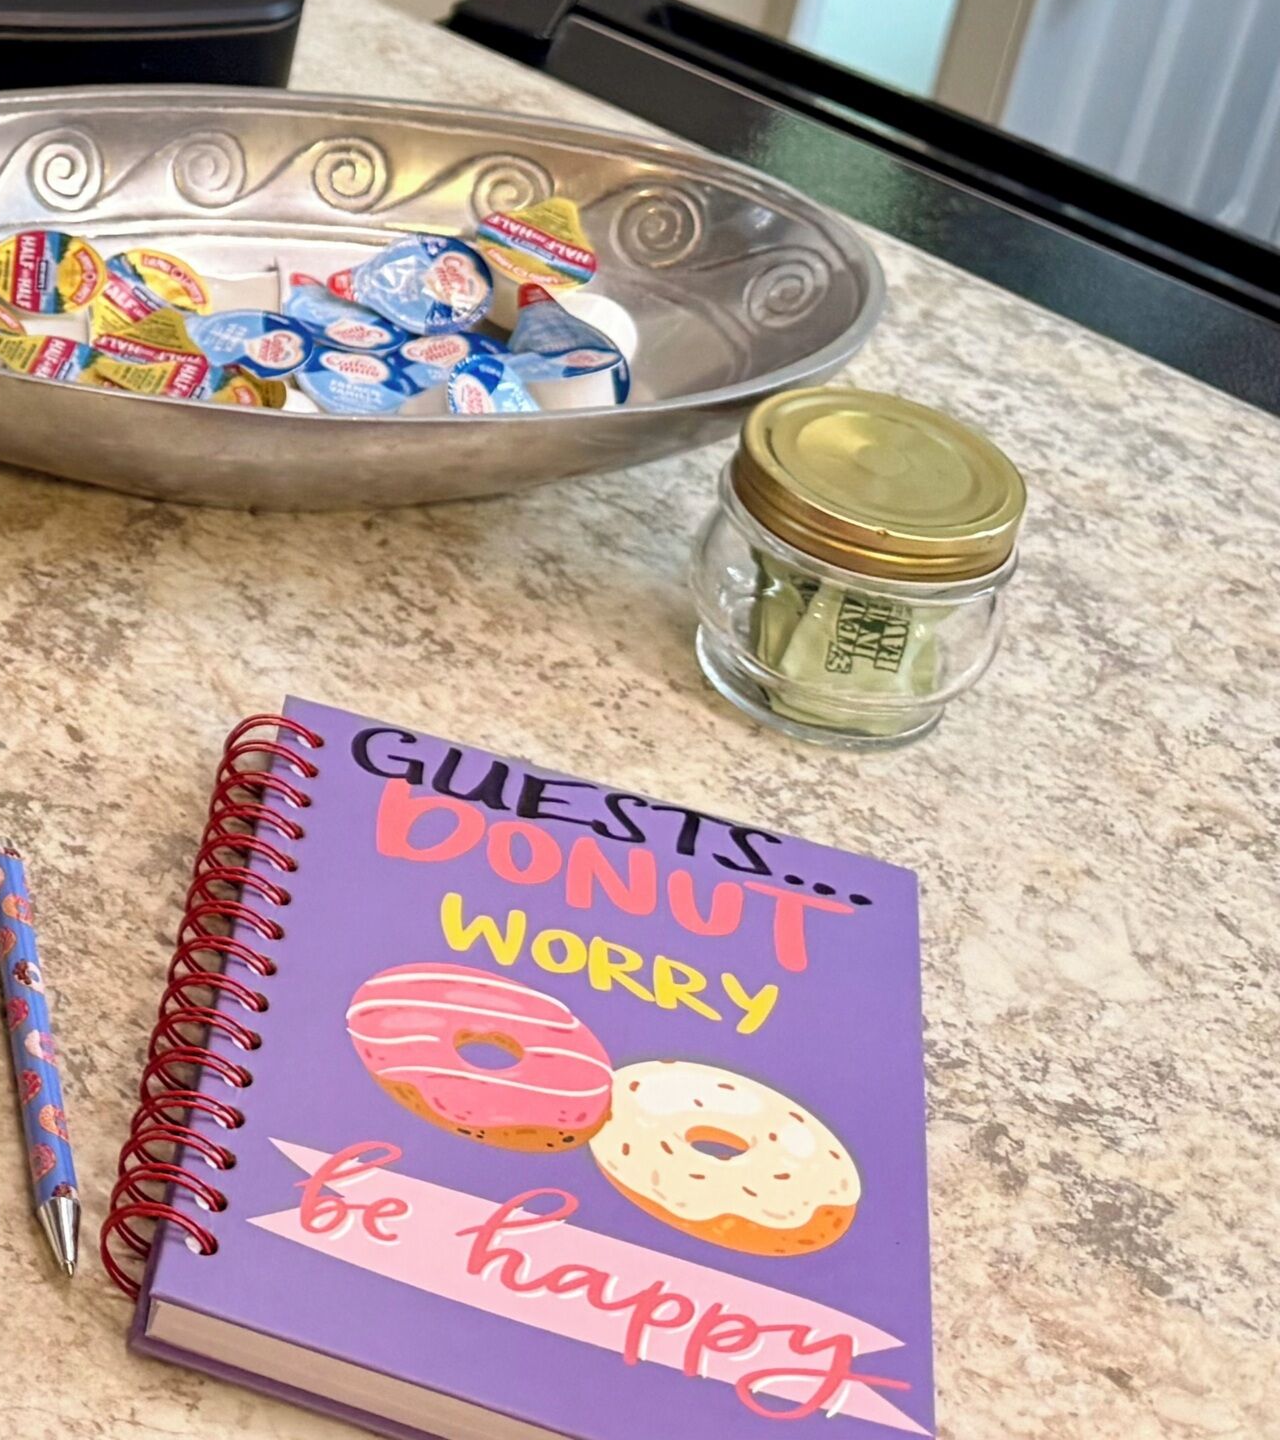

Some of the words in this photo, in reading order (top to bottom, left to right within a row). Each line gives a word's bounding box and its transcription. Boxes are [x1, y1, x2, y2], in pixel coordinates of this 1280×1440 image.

[19, 235, 38, 271] HALF
[487, 215, 534, 239] HALF
[546, 241, 590, 264] HALF
[15, 277, 33, 310] HALF
[351, 727, 873, 907] GUESTS...
[376, 779, 855, 972] DONUT
[440, 892, 779, 1035] WORRY
[294, 1140, 413, 1246] be
[454, 1187, 911, 1420] happy
